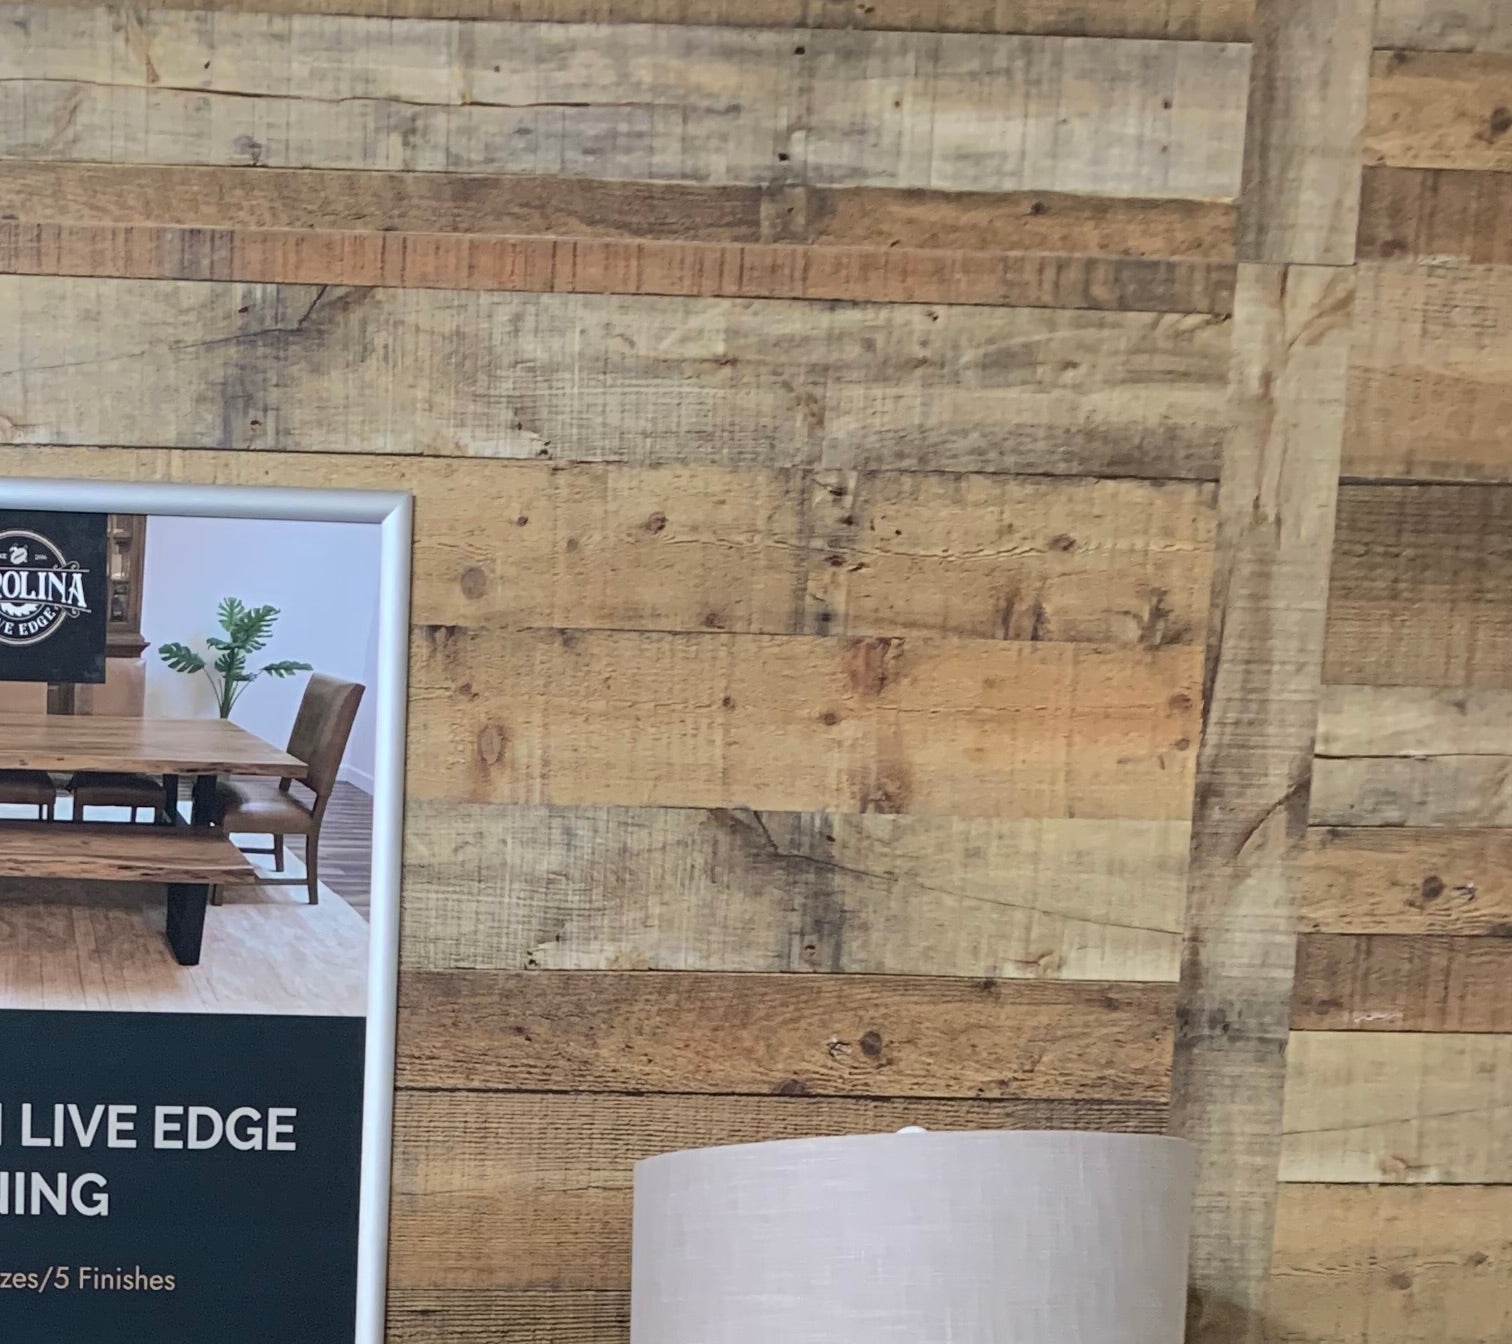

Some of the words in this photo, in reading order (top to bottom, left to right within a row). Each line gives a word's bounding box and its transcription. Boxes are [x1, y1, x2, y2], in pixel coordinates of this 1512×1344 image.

[18, 606, 56, 636] EDGE
[21, 1103, 137, 1149] LIVE
[153, 1106, 297, 1151] EDGE
[79, 1265, 176, 1291] Finishes
